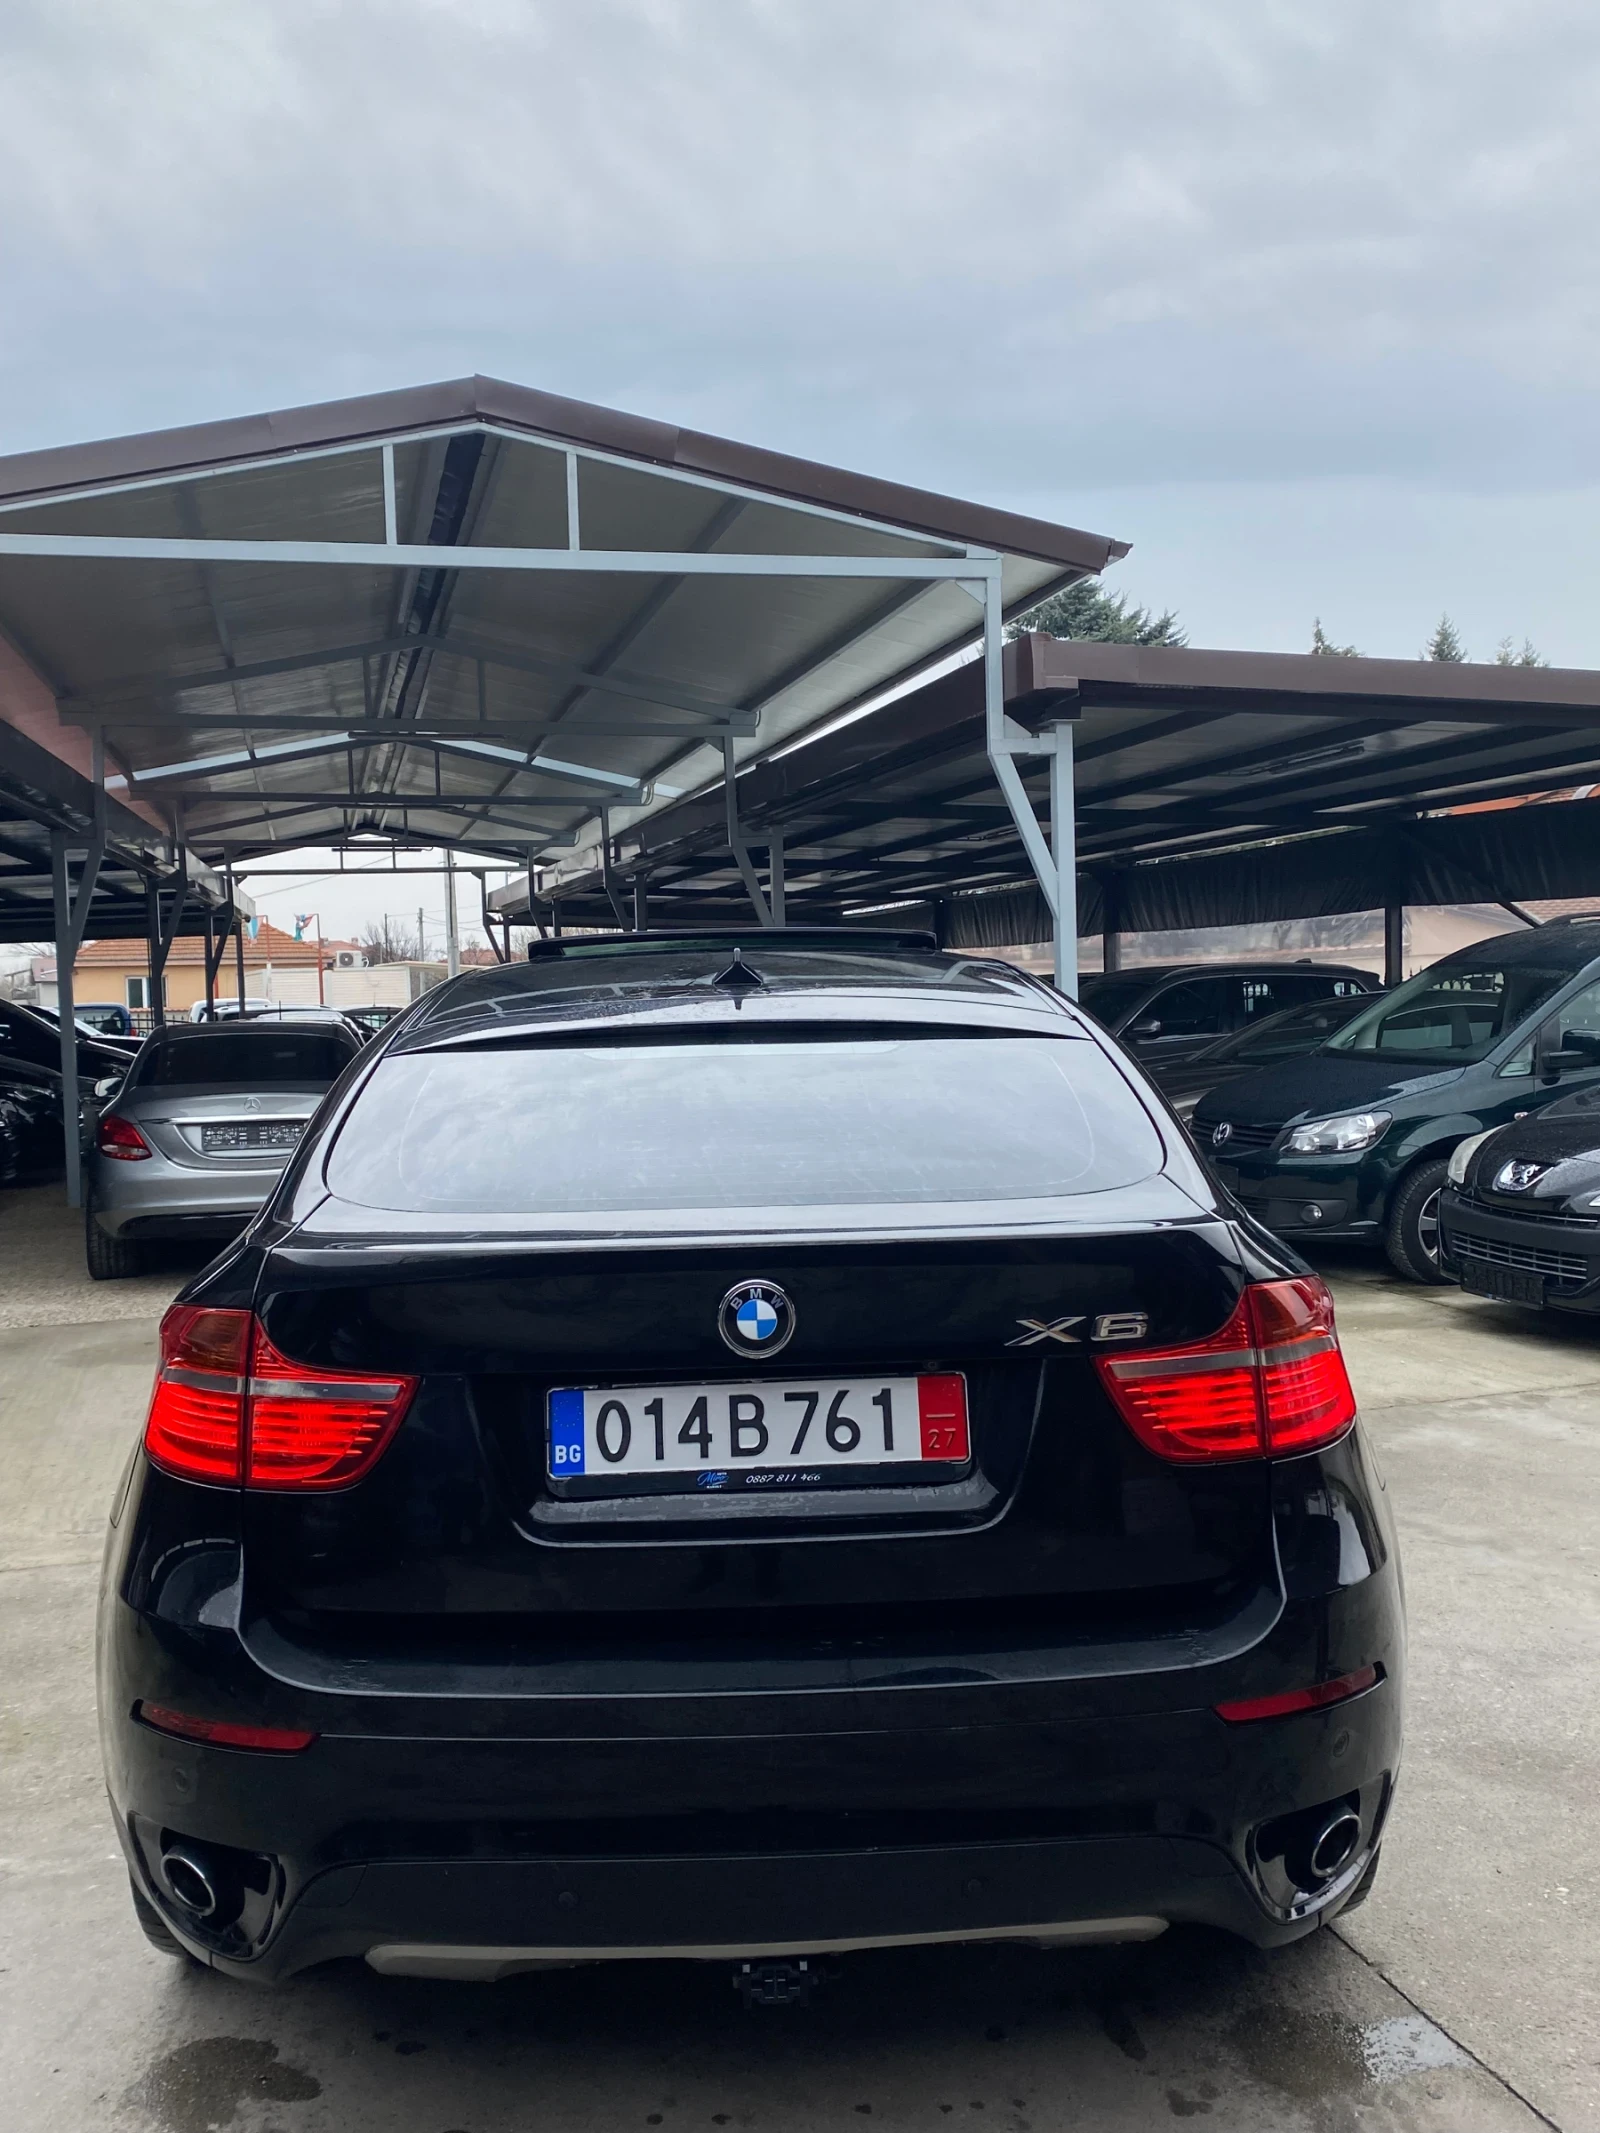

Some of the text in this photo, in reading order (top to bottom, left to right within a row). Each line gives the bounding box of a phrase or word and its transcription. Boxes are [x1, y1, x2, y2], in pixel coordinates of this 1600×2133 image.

[730, 1288, 784, 1310] BMW
[1004, 1312, 1149, 1346] X6
[554, 1388, 895, 1464] BG 014B761
[927, 1427, 957, 1449] 27
[745, 1472, 822, 1484] 0887 811 466
